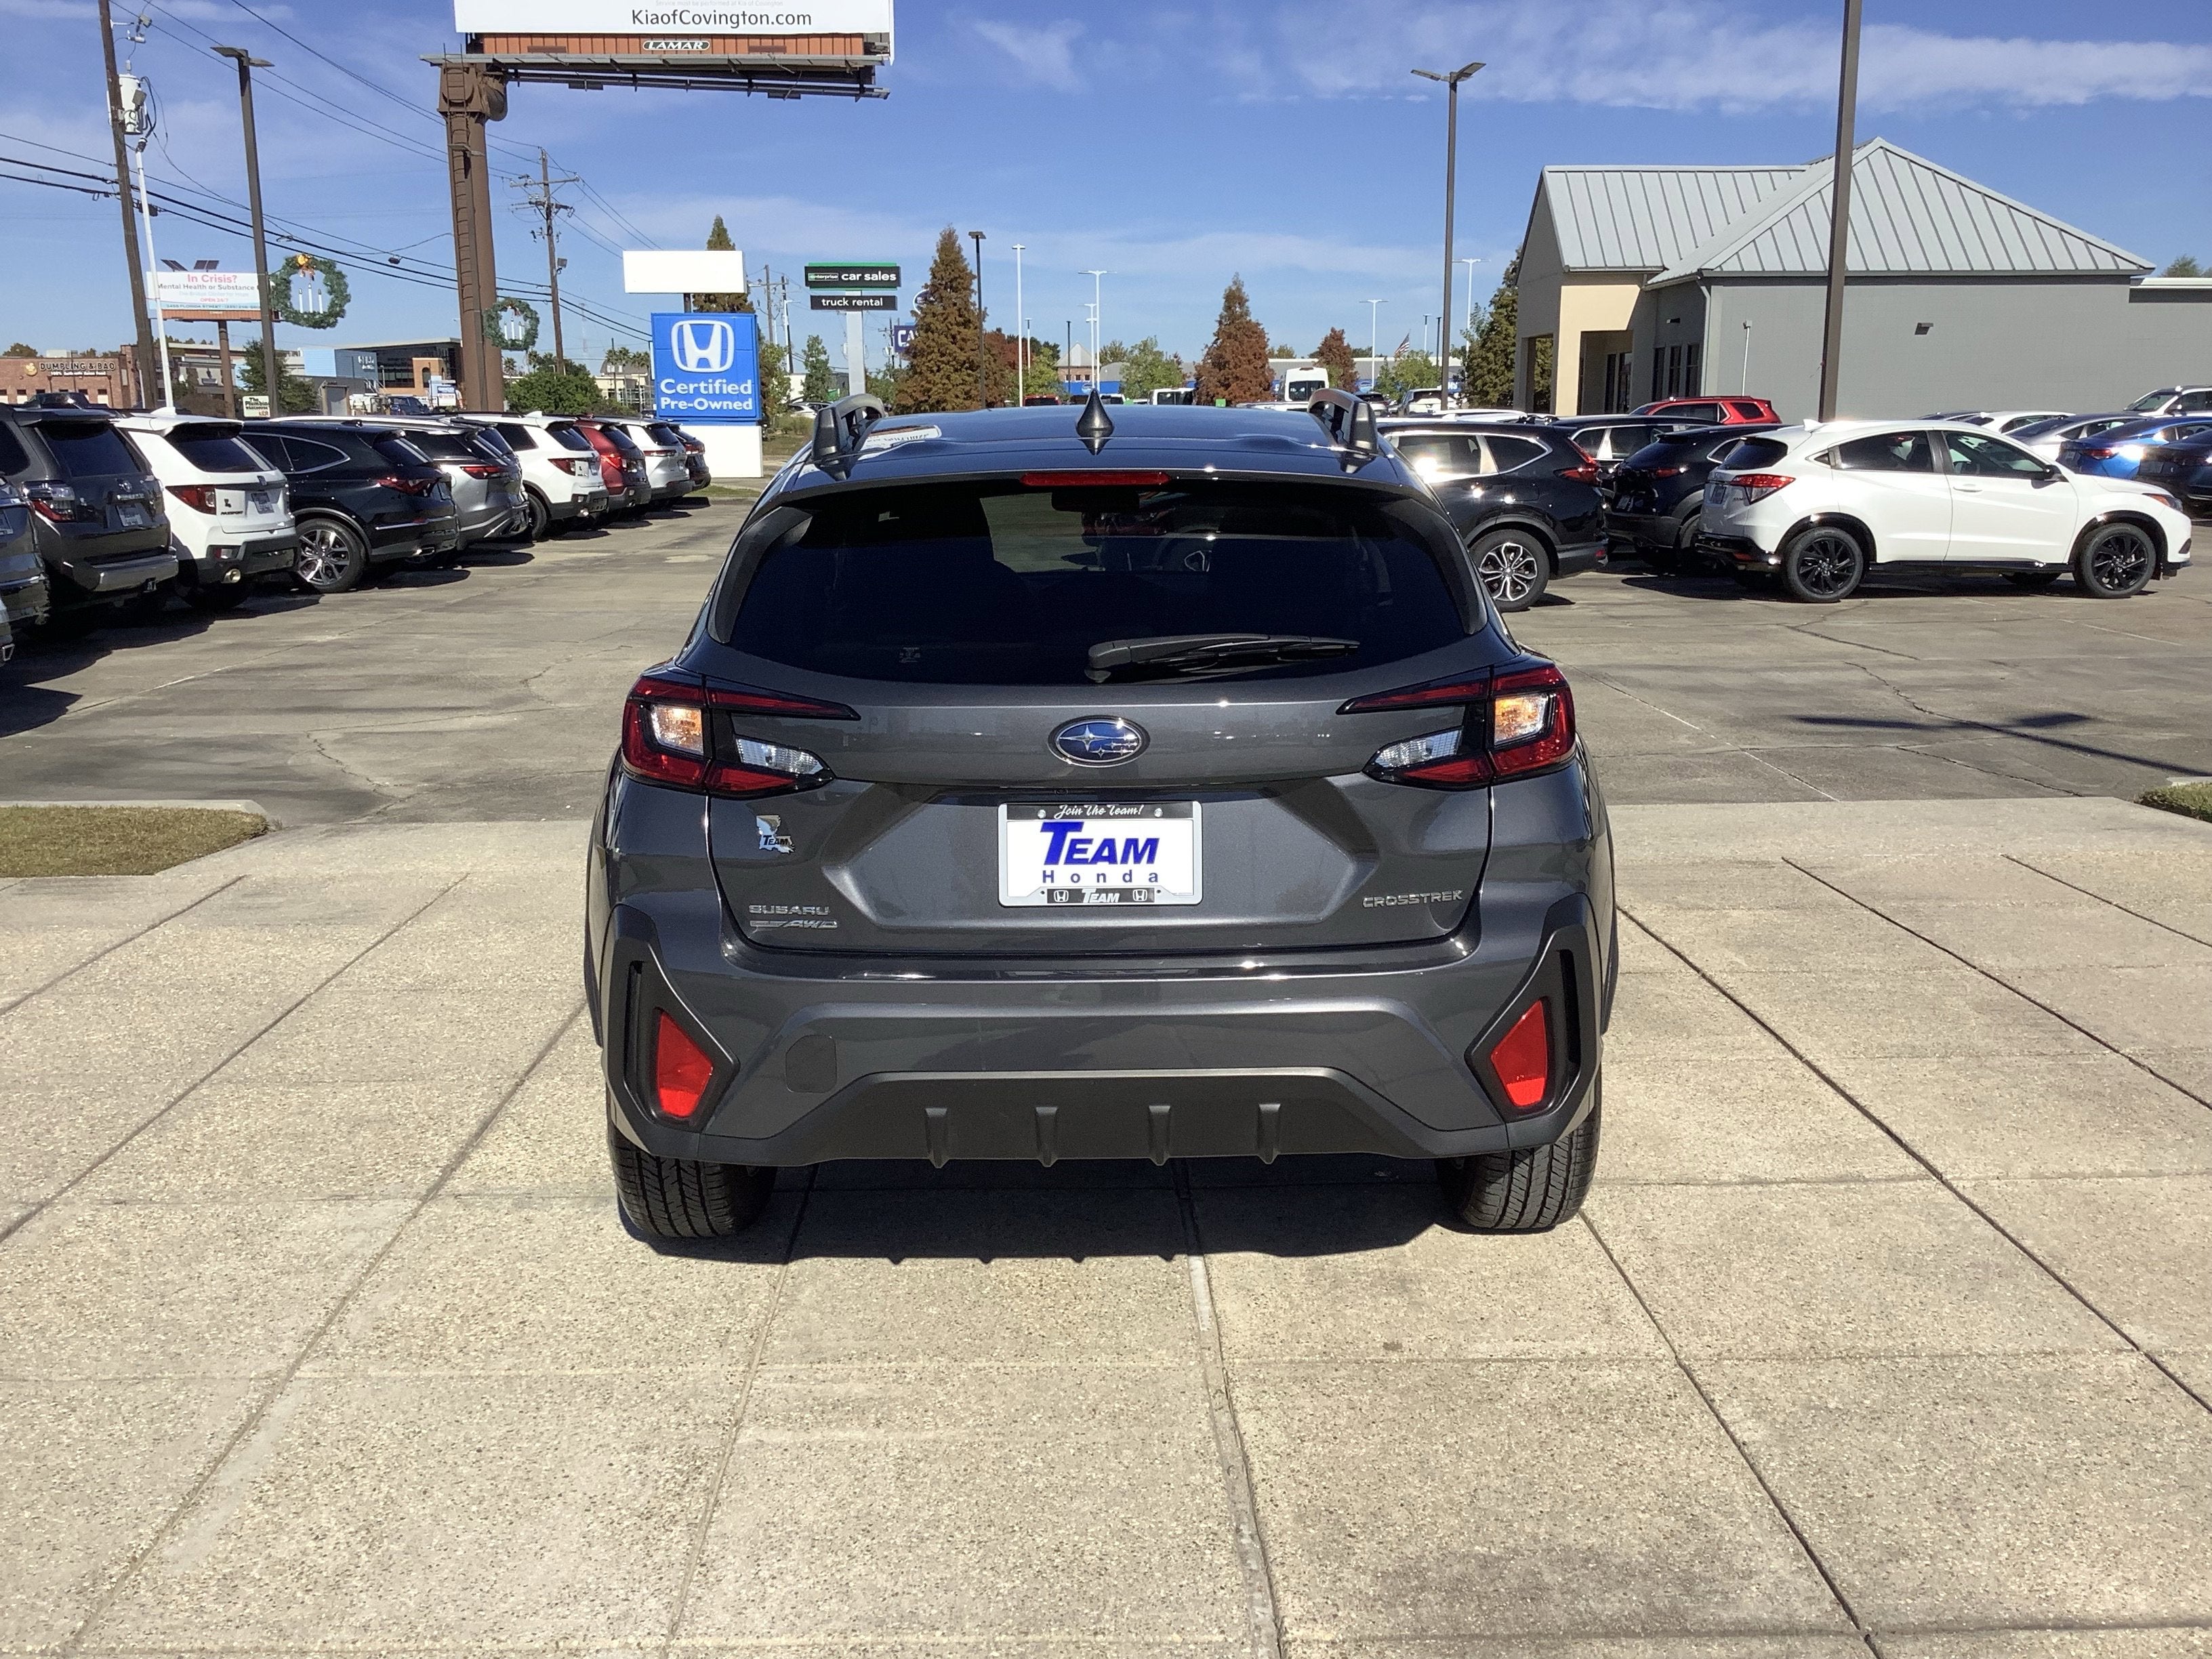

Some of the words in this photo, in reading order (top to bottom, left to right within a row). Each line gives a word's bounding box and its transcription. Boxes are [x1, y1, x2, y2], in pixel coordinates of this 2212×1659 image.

[632, 9, 812, 28] KiaofCovington.com
[648, 41, 703, 49] LAMAR
[187, 274, 198, 282] In
[201, 274, 237, 283] Crisis?
[864, 270, 897, 281] sales
[821, 298, 849, 306] truck
[852, 298, 883, 306] rental
[40, 363, 85, 371] DUMPLING
[660, 378, 752, 394] Certified
[660, 397, 753, 411] Pre-Owned
[1054, 804, 1084, 819] Join
[1083, 804, 1106, 816] The
[1106, 804, 1145, 816] Team!
[1042, 869, 1159, 884] Honda
[1362, 890, 1464, 908] CROSSTREK
[749, 905, 830, 915] SUBARU
